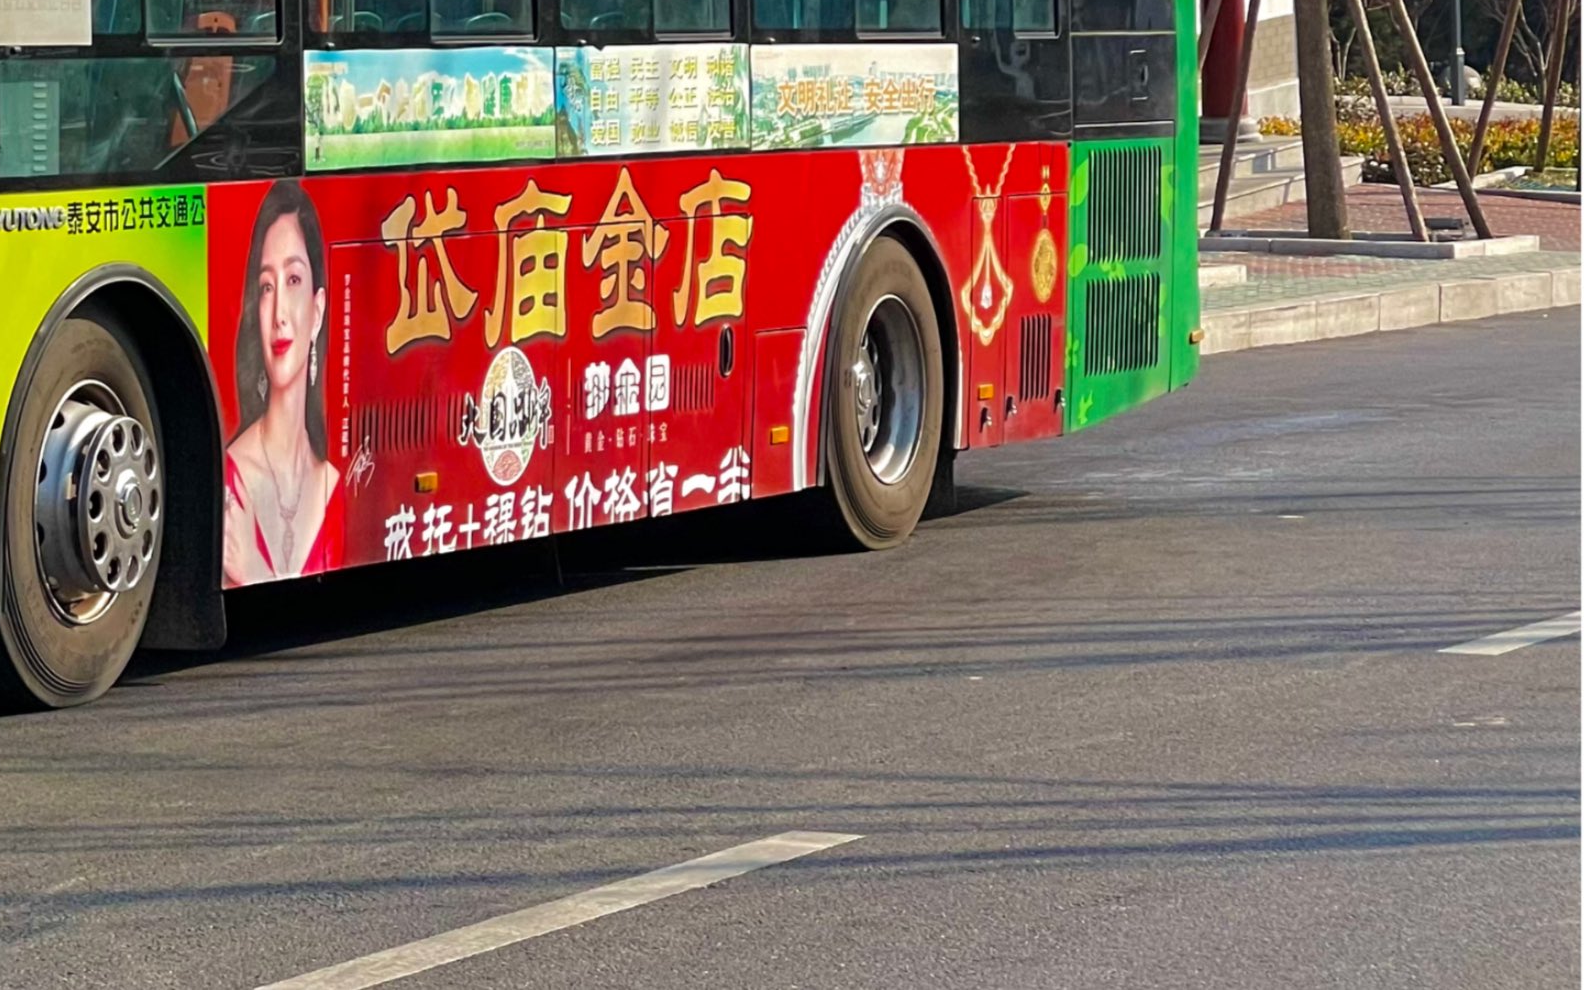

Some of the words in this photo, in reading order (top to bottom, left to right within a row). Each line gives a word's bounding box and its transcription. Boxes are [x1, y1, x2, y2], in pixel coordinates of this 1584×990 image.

[590, 57, 621, 81] 富强
[630, 57, 660, 80] 民主
[669, 56, 698, 79] 文明
[706, 55, 735, 79] 和谐
[590, 86, 620, 112] 自由
[629, 87, 660, 111] 平等
[669, 86, 698, 109] 公正
[707, 84, 735, 107] 法治
[778, 78, 854, 115] 文明礼让
[864, 77, 936, 113] 安全出行
[591, 120, 622, 146] 爱国
[631, 120, 661, 144] 敬业
[669, 119, 698, 142] 诚信
[707, 118, 736, 141] 友善
[67, 195, 206, 235] 泰安市公共交通公
[381, 165, 754, 354] 岱庙金店
[384, 484, 554, 560] 戒托+裸钻
[564, 444, 751, 531] 价格省一半
